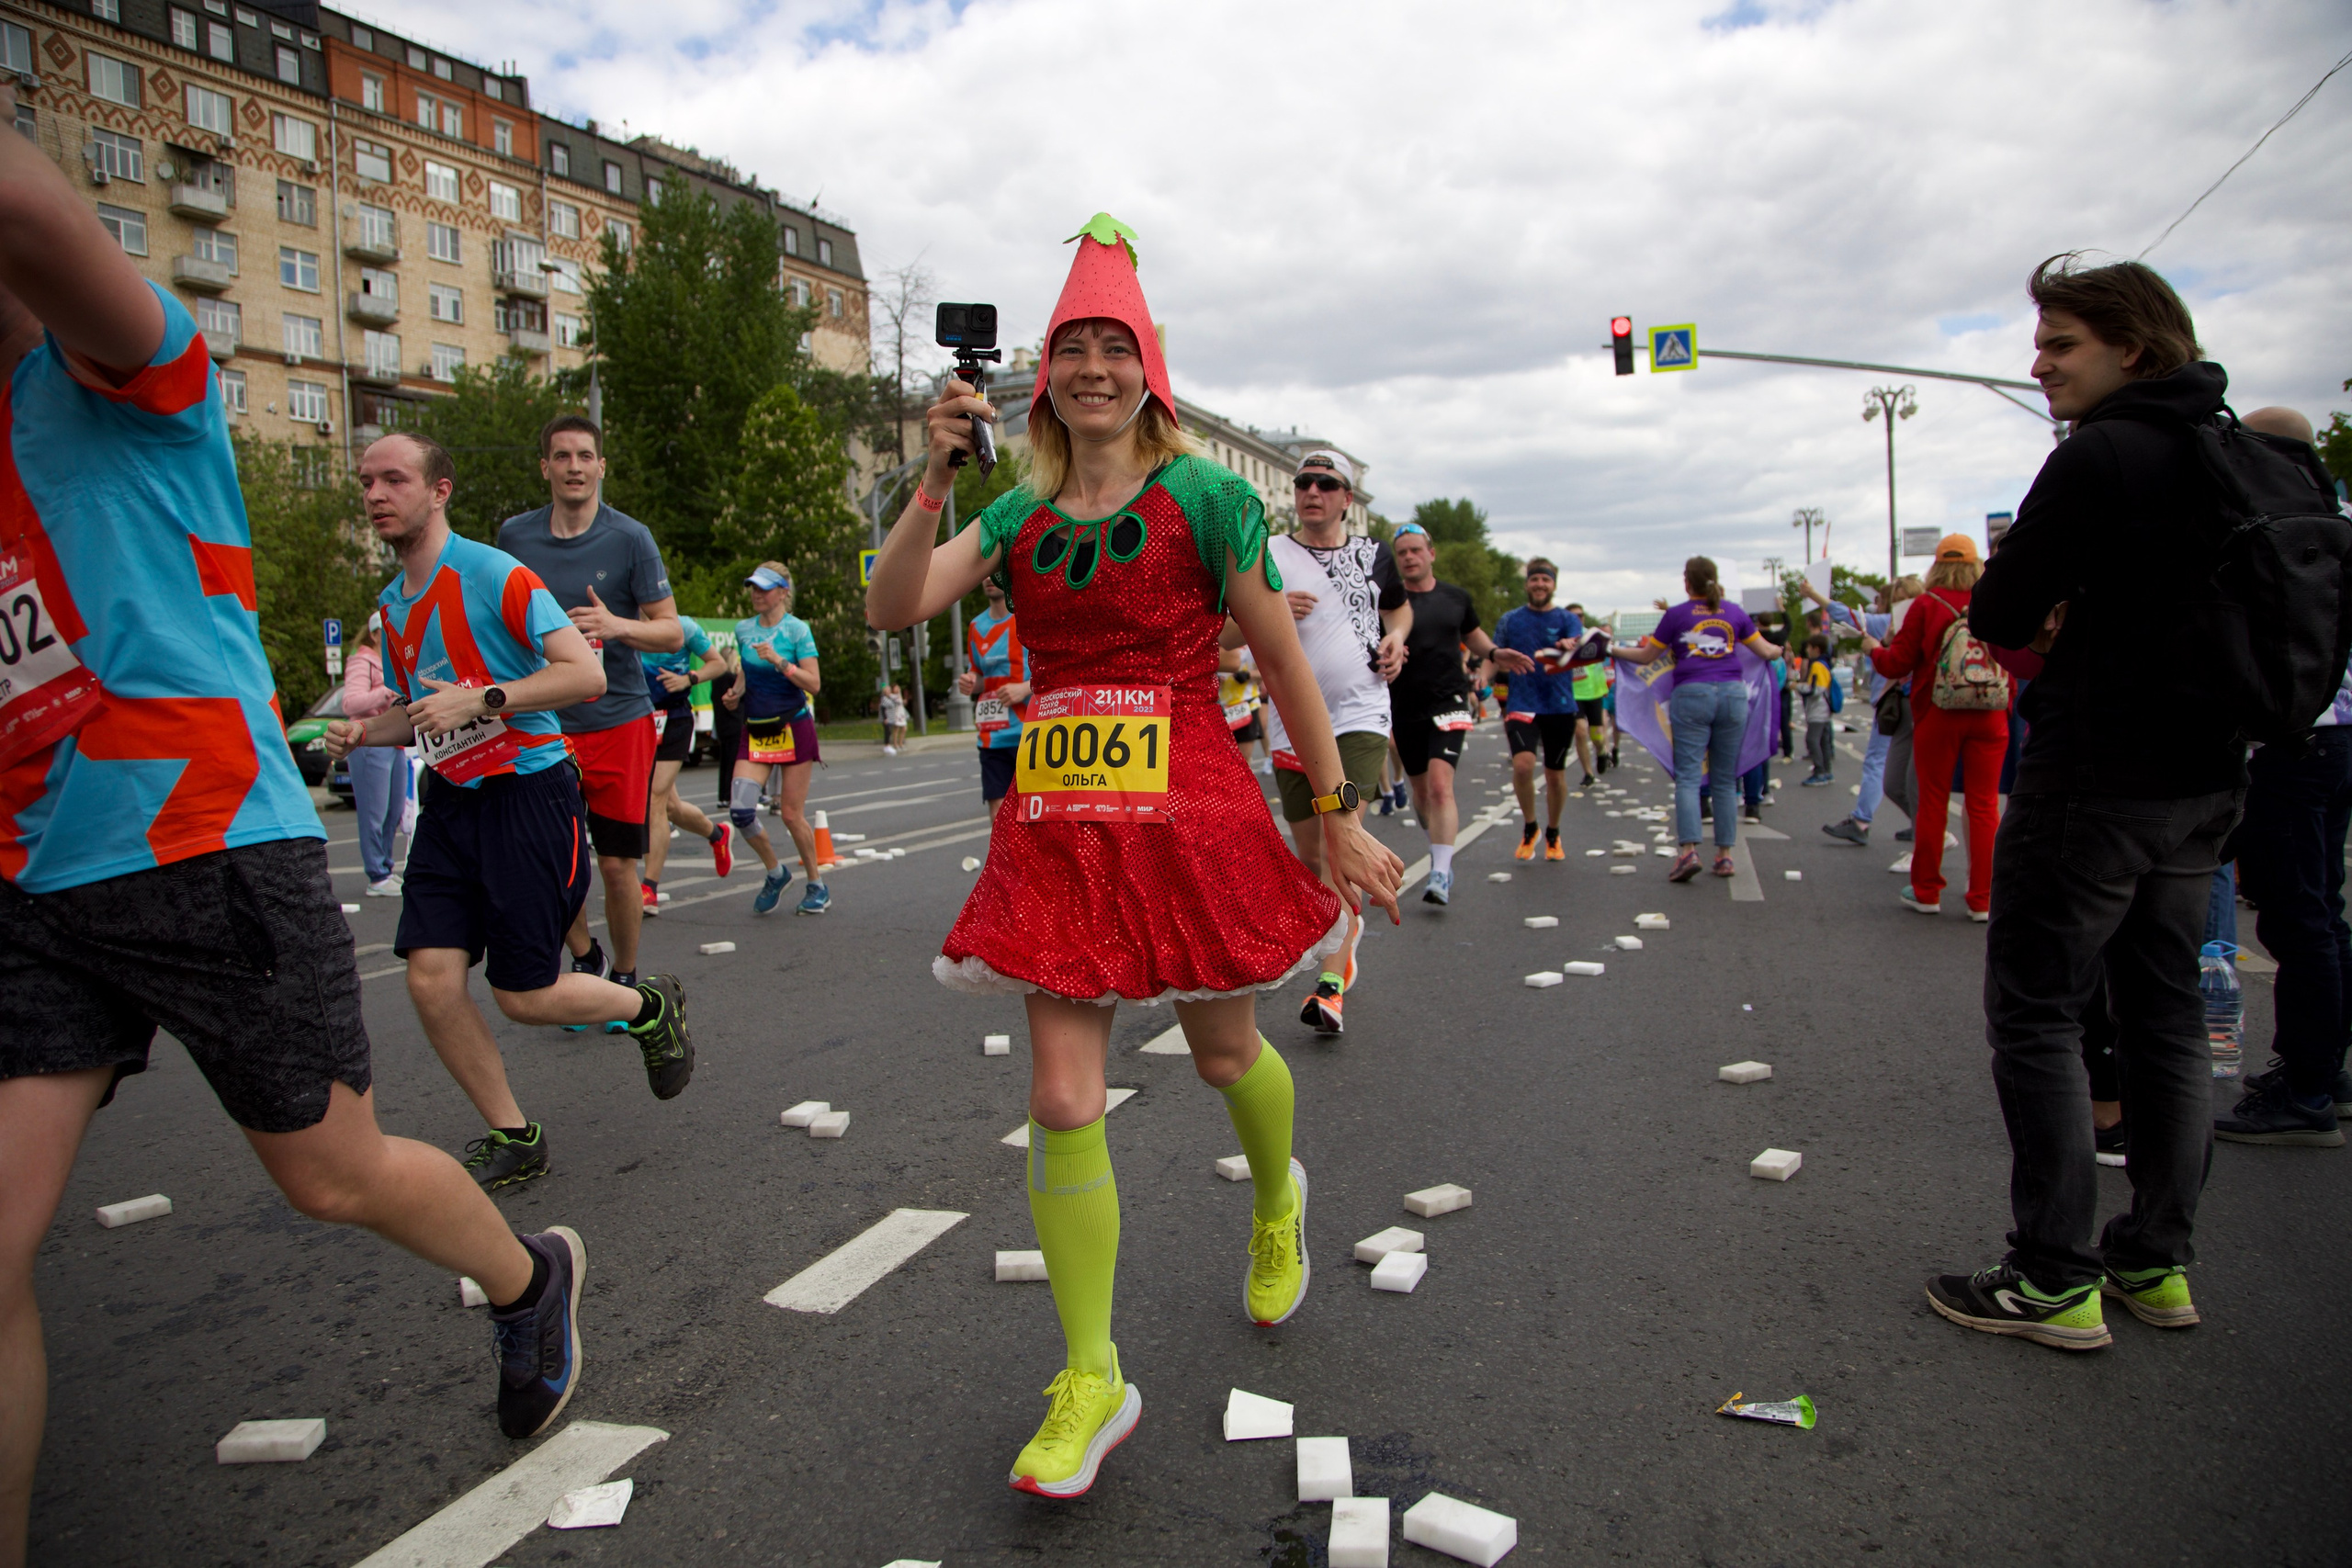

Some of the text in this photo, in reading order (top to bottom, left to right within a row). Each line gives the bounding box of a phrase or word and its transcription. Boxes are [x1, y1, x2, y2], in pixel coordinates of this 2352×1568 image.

[0, 556, 18, 579] М
[328, 622, 339, 643] P
[978, 700, 1004, 716] 3852
[1037, 706, 1068, 717] МАРАФОН
[434, 730, 487, 761] КОНСТАНТИН
[1024, 723, 1159, 770] 10061
[1062, 773, 1108, 787] ОЛЬГА
[1029, 795, 1044, 819] D
[1295, 1213, 1303, 1265] HOKA
